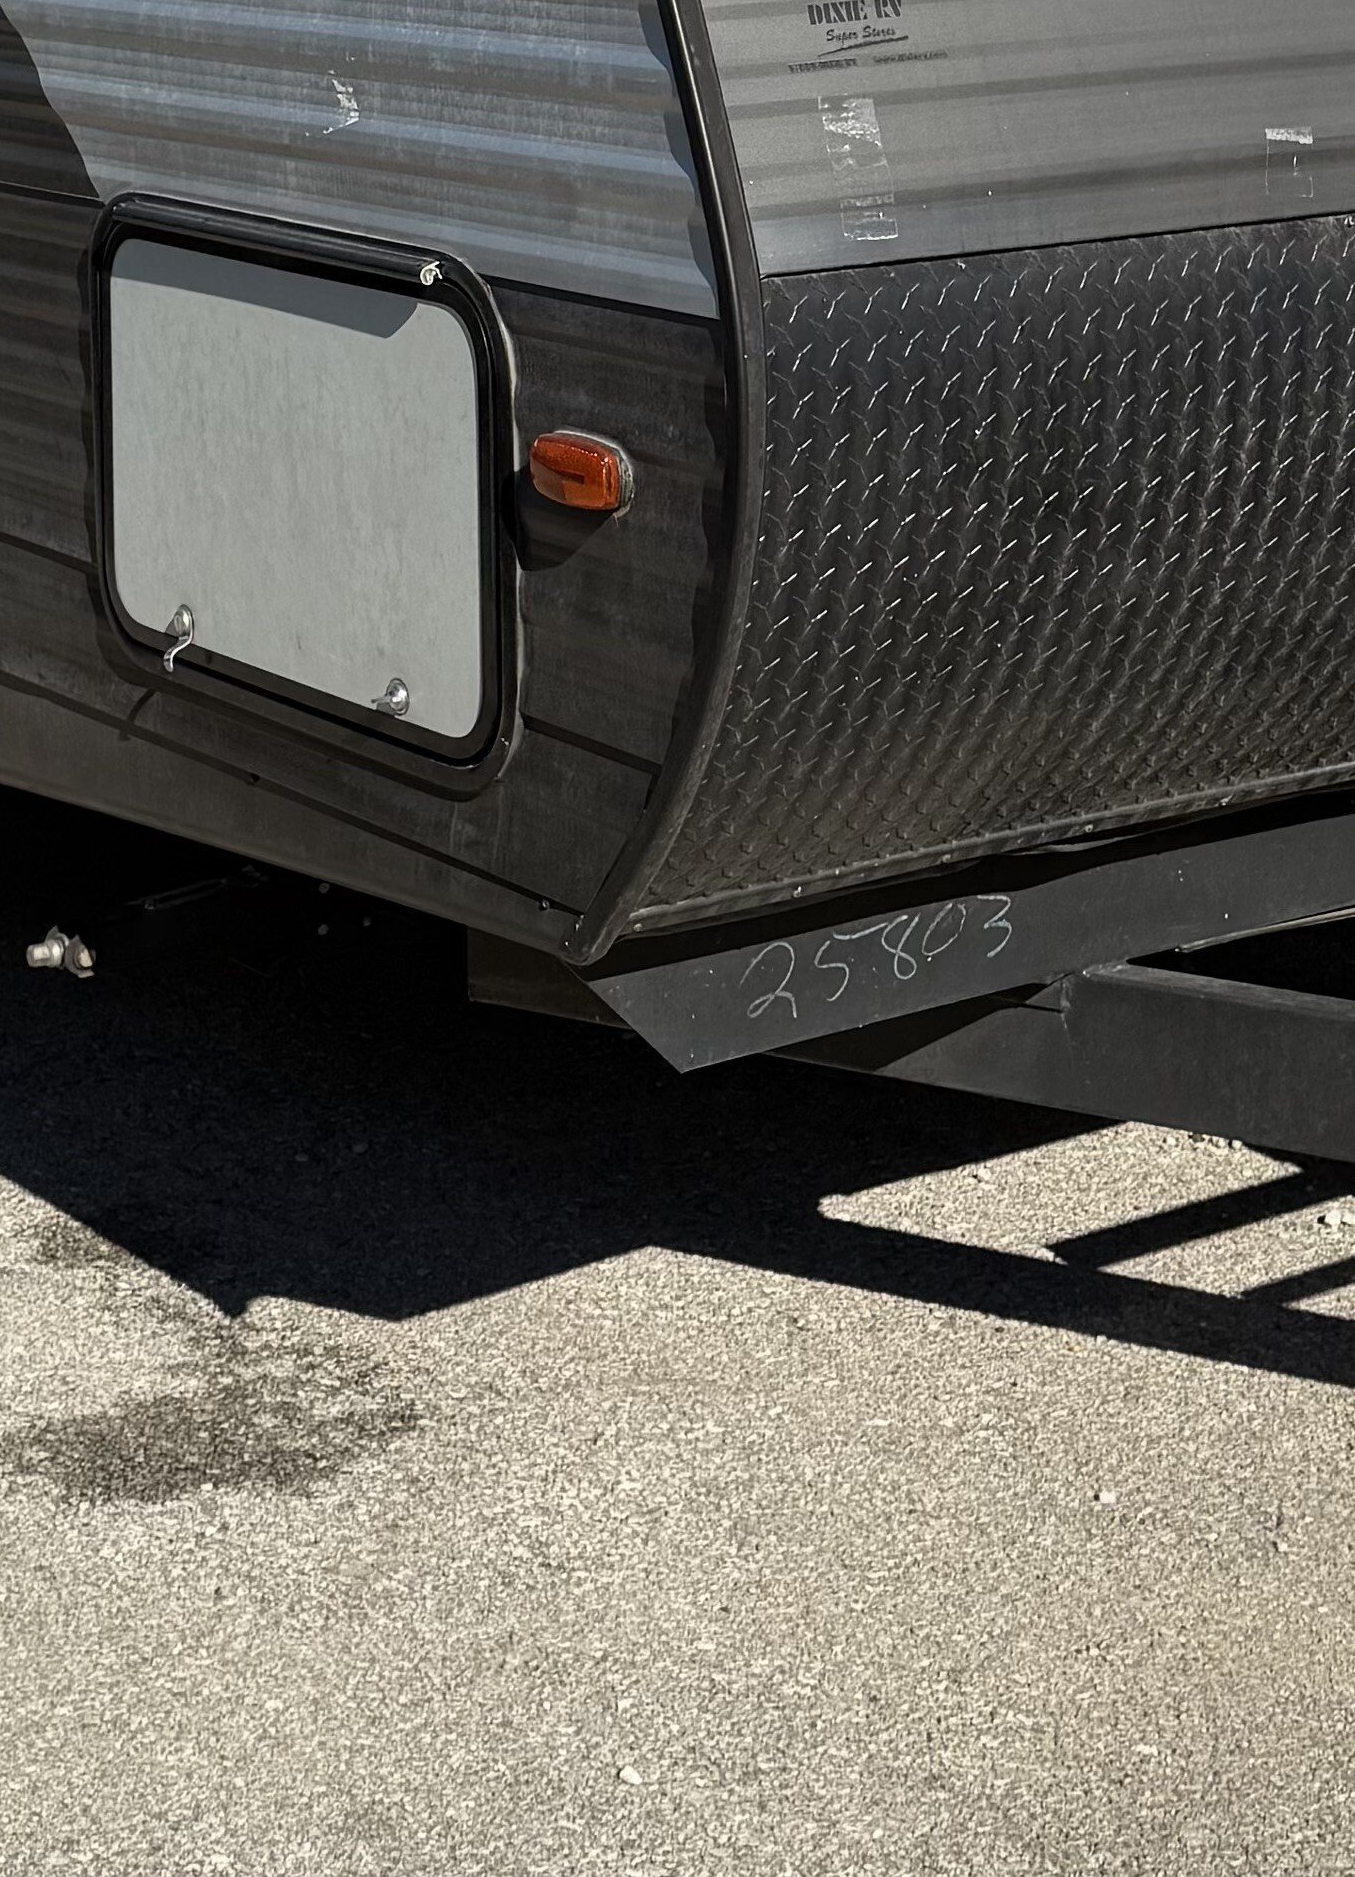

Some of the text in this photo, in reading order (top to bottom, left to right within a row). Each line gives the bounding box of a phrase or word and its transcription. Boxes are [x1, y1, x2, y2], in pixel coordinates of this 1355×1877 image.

[807, 0, 868, 25] DIXIE
[826, 28, 859, 48] Super
[738, 893, 1013, 1019] 25803
